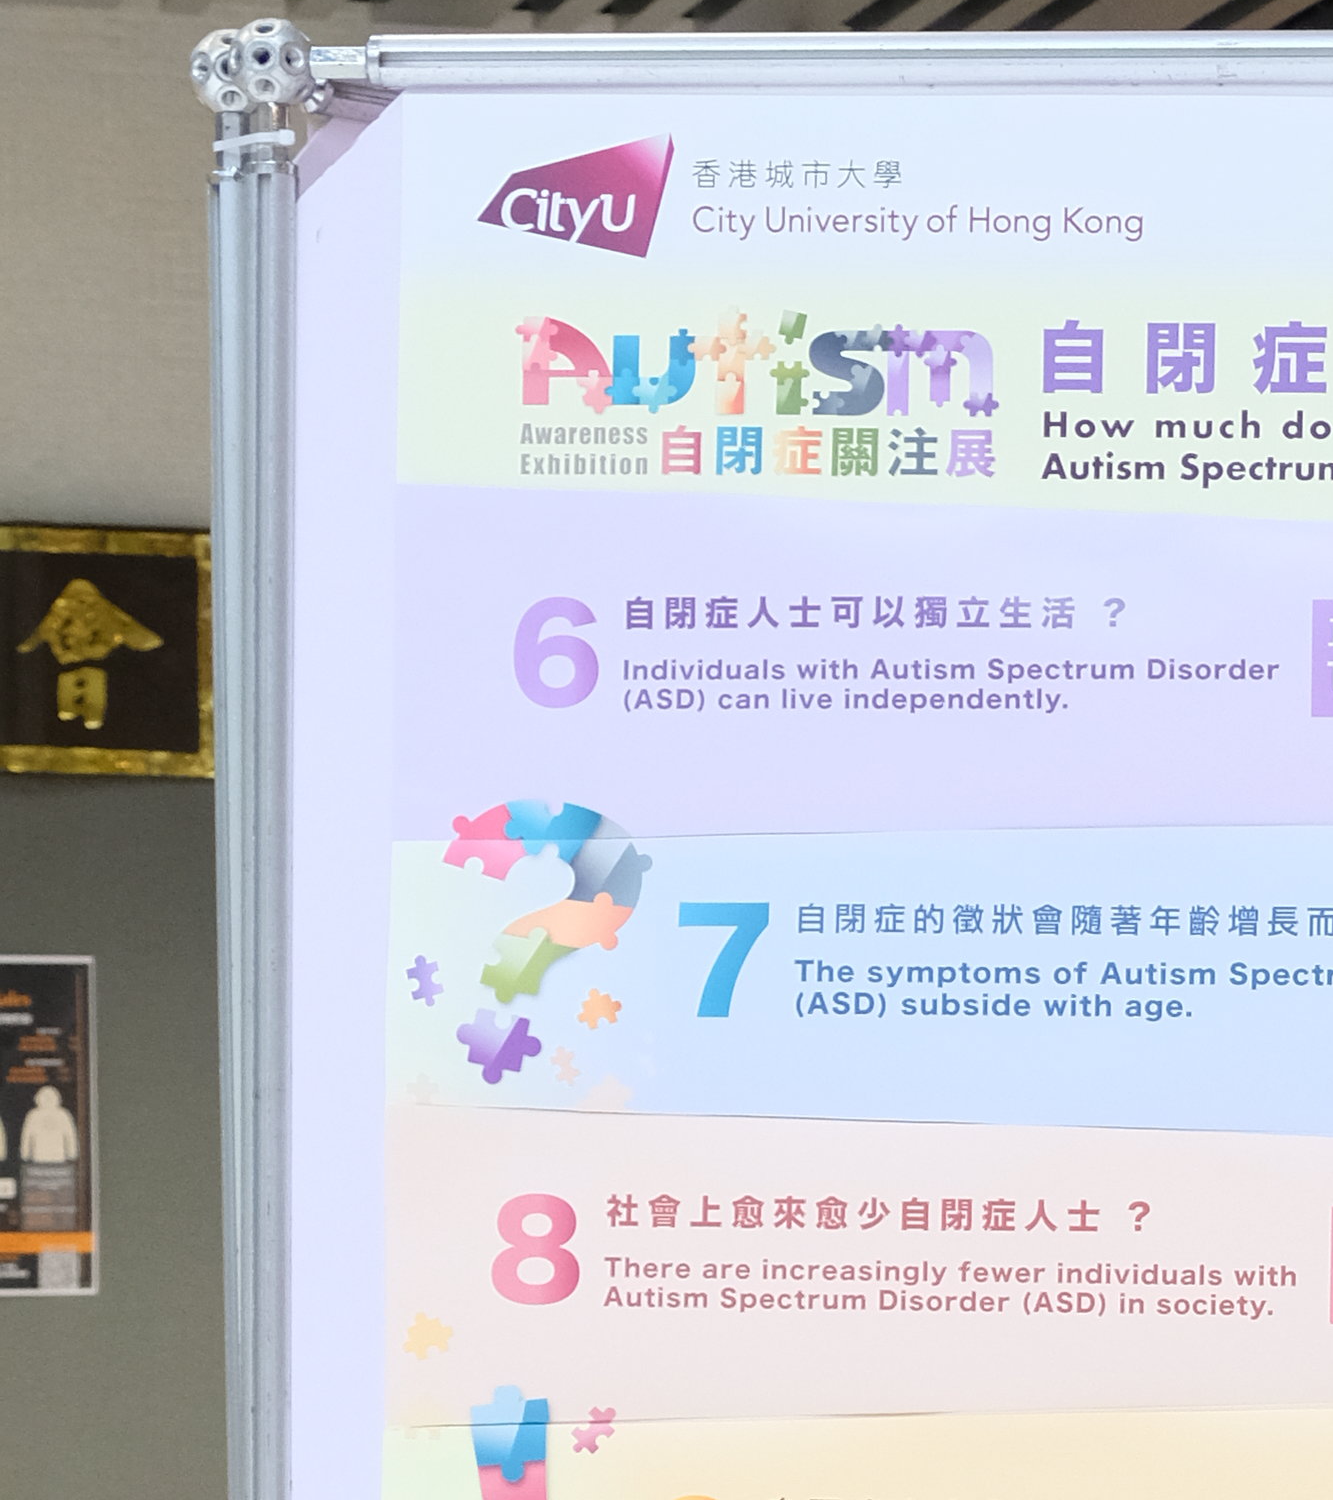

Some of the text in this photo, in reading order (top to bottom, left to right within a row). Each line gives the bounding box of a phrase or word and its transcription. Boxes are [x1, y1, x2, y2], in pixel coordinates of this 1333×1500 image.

[692, 159, 902, 189] 香港城市大學
[501, 188, 636, 242] CityU
[692, 204, 1144, 242] City University of Hong Kong
[519, 422, 648, 445] Awareness
[1043, 410, 1135, 439] How
[1155, 409, 1261, 439] much
[1282, 409, 1332, 440] do
[520, 453, 648, 476] Exhibition
[660, 425, 996, 478] 自閉症關注展
[1041, 450, 1165, 481] Autism
[626, 595, 1126, 630] 自閉症人士可以獨立生活？
[513, 596, 599, 708] 6
[623, 657, 1280, 684] Individuals with Autism Spectrum Disorder
[623, 687, 1068, 714] (ASD) can live independently.
[678, 902, 769, 1017] 7
[794, 959, 855, 983] The
[867, 962, 1041, 989] symptoms
[1053, 961, 1088, 985] of
[1099, 961, 1216, 986] Autism
[795, 991, 1192, 1022] (ASD) subside with age.
[606, 1193, 1151, 1232] 社會上愈來愈少自閉症人士？
[491, 1193, 580, 1305] 8
[603, 1256, 1297, 1287] There are increasingly fewer individuals with
[603, 1285, 1274, 1321] Autism Spectrum Disorder (ASD) in society.
